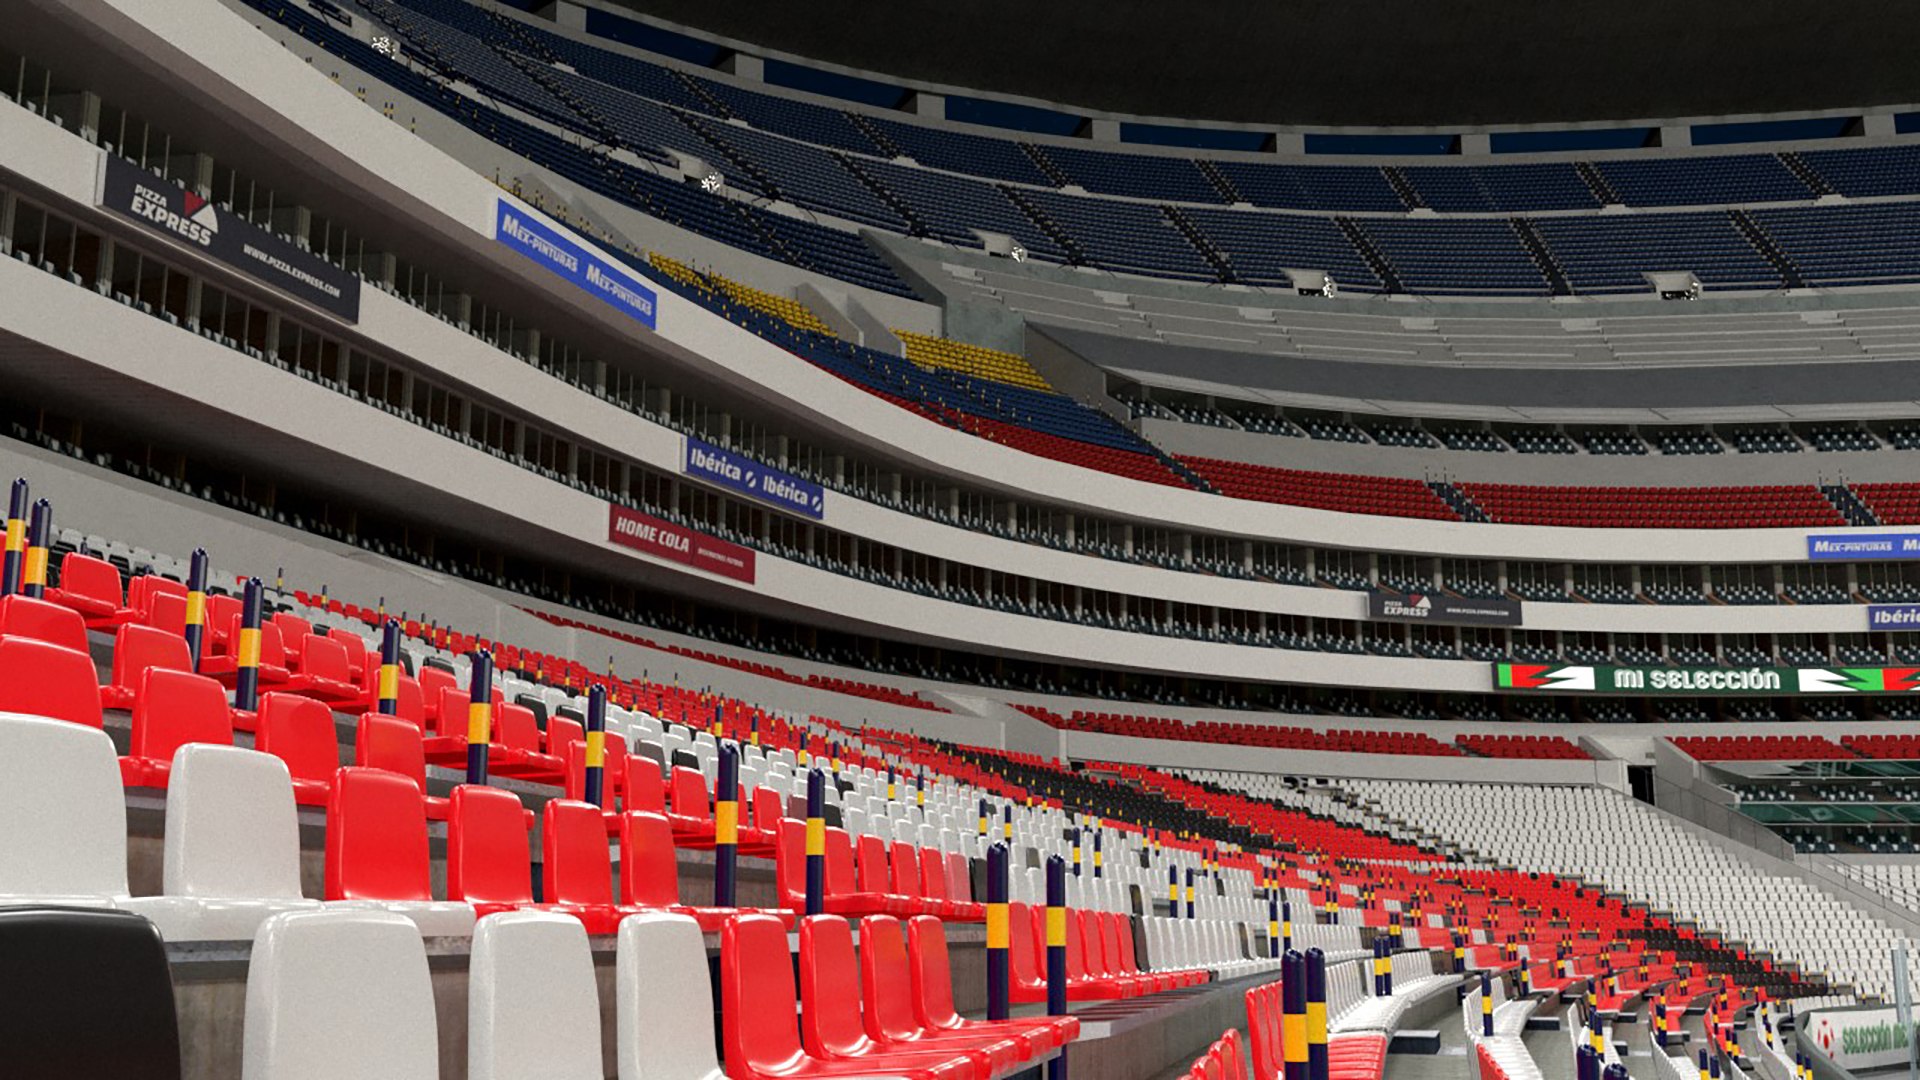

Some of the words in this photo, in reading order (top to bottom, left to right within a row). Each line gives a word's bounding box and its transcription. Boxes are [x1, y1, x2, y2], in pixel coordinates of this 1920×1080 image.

[135, 183, 167, 207] PIZZA
[131, 196, 212, 247] EXPRESS
[243, 243, 341, 299] WWW.PIZZA.EXPRESS.COM
[691, 447, 741, 481] Ibérica
[763, 474, 808, 506] Ibérica
[616, 516, 656, 542] HOME
[658, 530, 690, 553] COLA
[1383, 606, 1429, 617] EXPRESS
[1614, 669, 1644, 689] MI
[1650, 667, 1781, 690] SELECCIÓN
